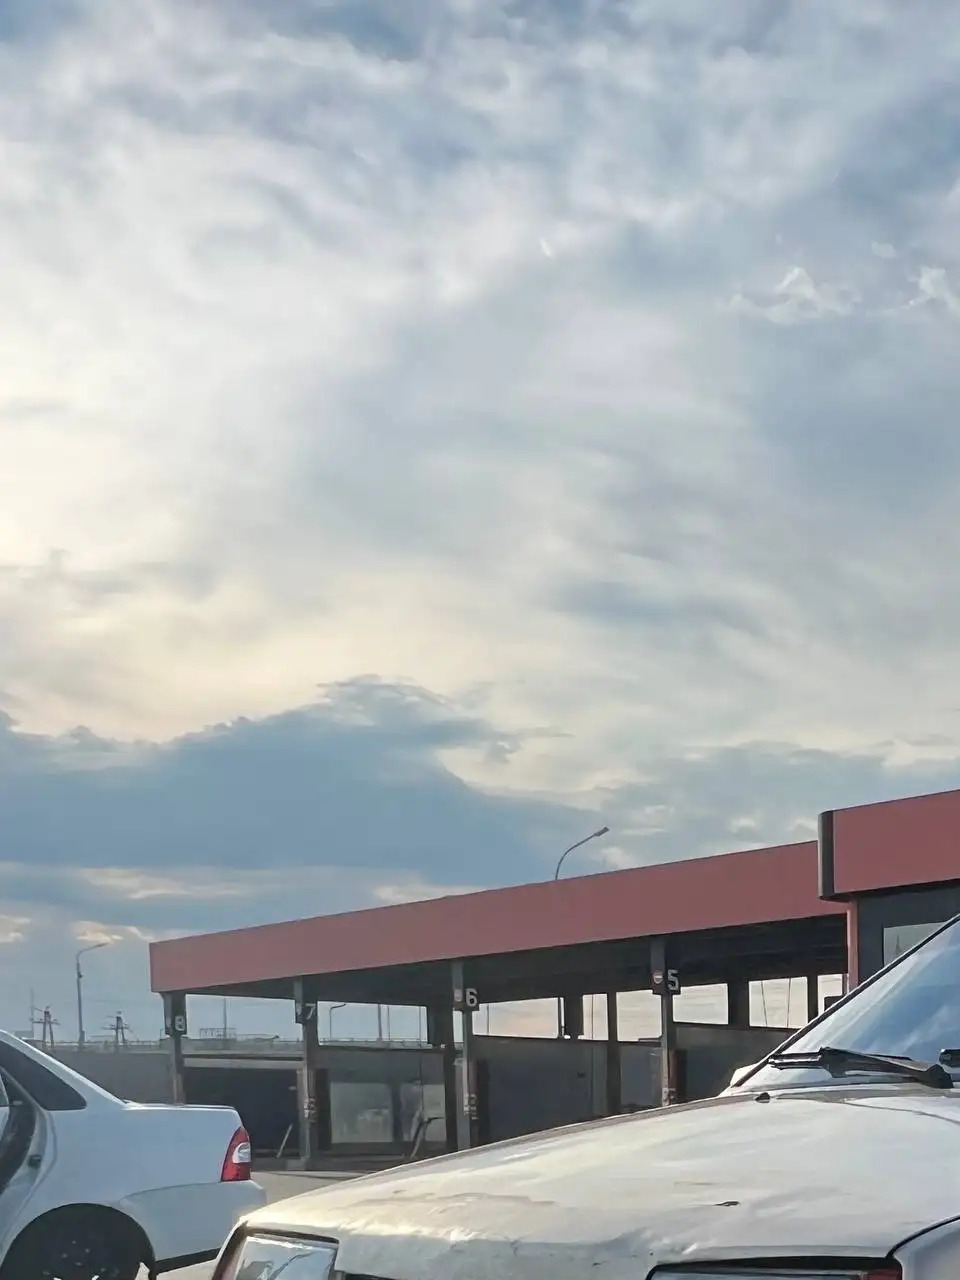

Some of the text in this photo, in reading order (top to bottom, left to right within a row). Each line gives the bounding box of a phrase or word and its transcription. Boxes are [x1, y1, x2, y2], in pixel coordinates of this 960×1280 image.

[667, 969, 679, 990] 5
[465, 988, 478, 1007] 6
[305, 1002, 316, 1020] 7
